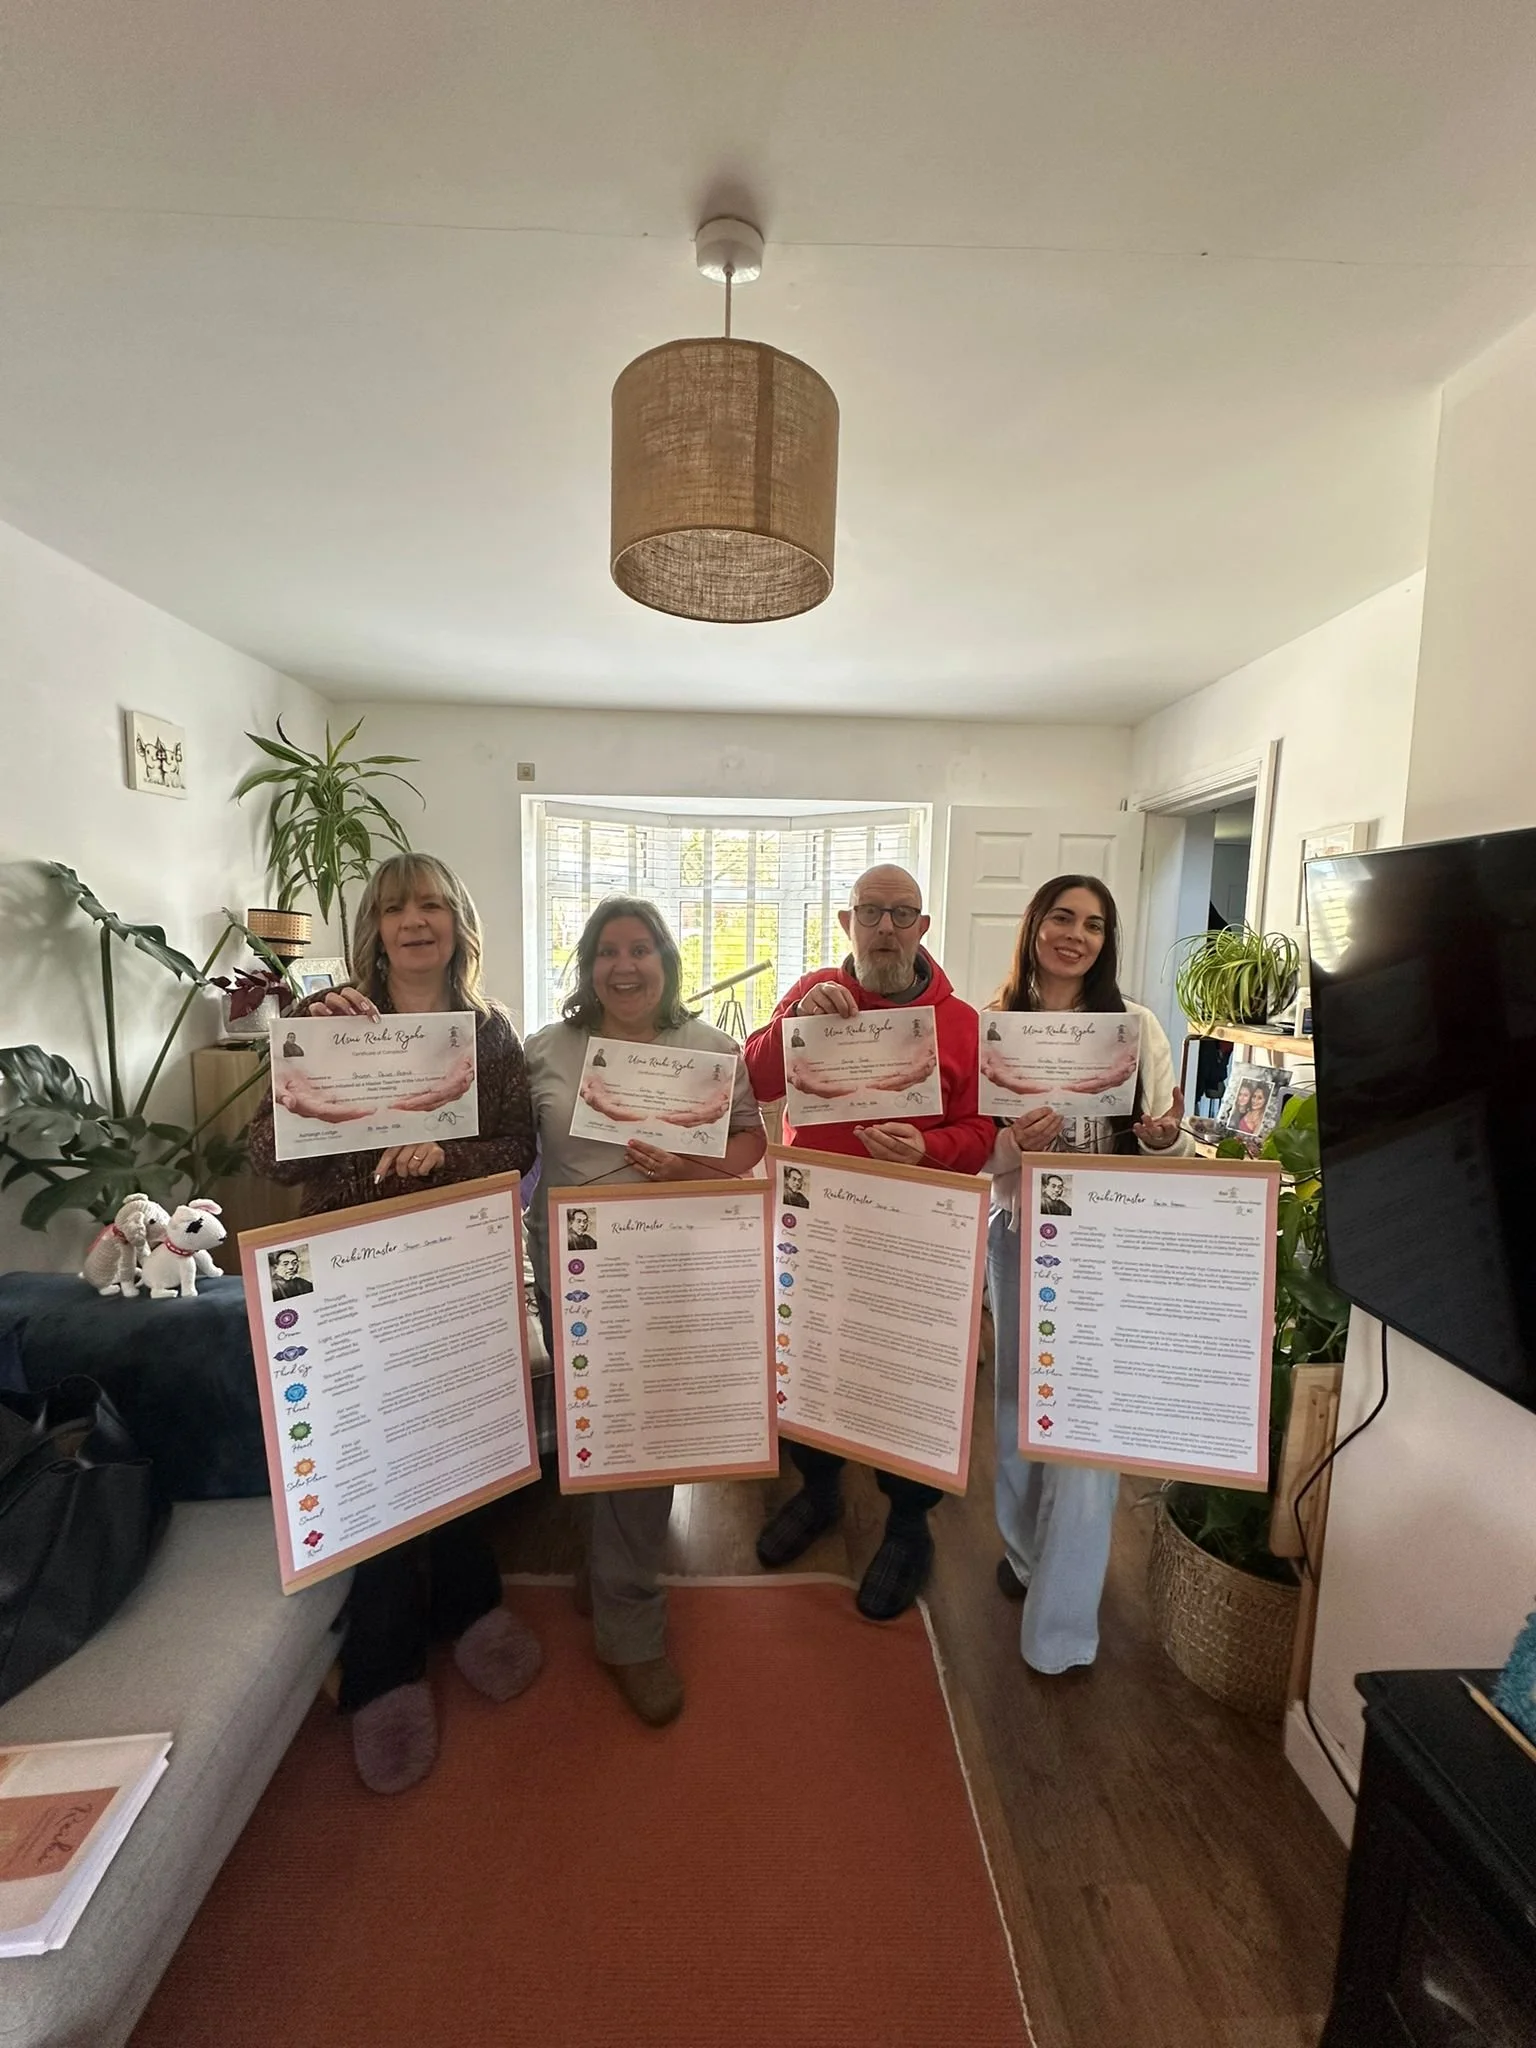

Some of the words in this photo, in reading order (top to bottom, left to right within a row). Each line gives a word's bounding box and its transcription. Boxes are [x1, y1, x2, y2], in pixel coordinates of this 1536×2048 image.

[364, 1028, 392, 1044] Reiki
[1088, 1190, 1114, 1203] Reiki
[1115, 1192, 1146, 1204] Master
[331, 1248, 362, 1268] Reiki
[362, 1242, 398, 1259] Master
